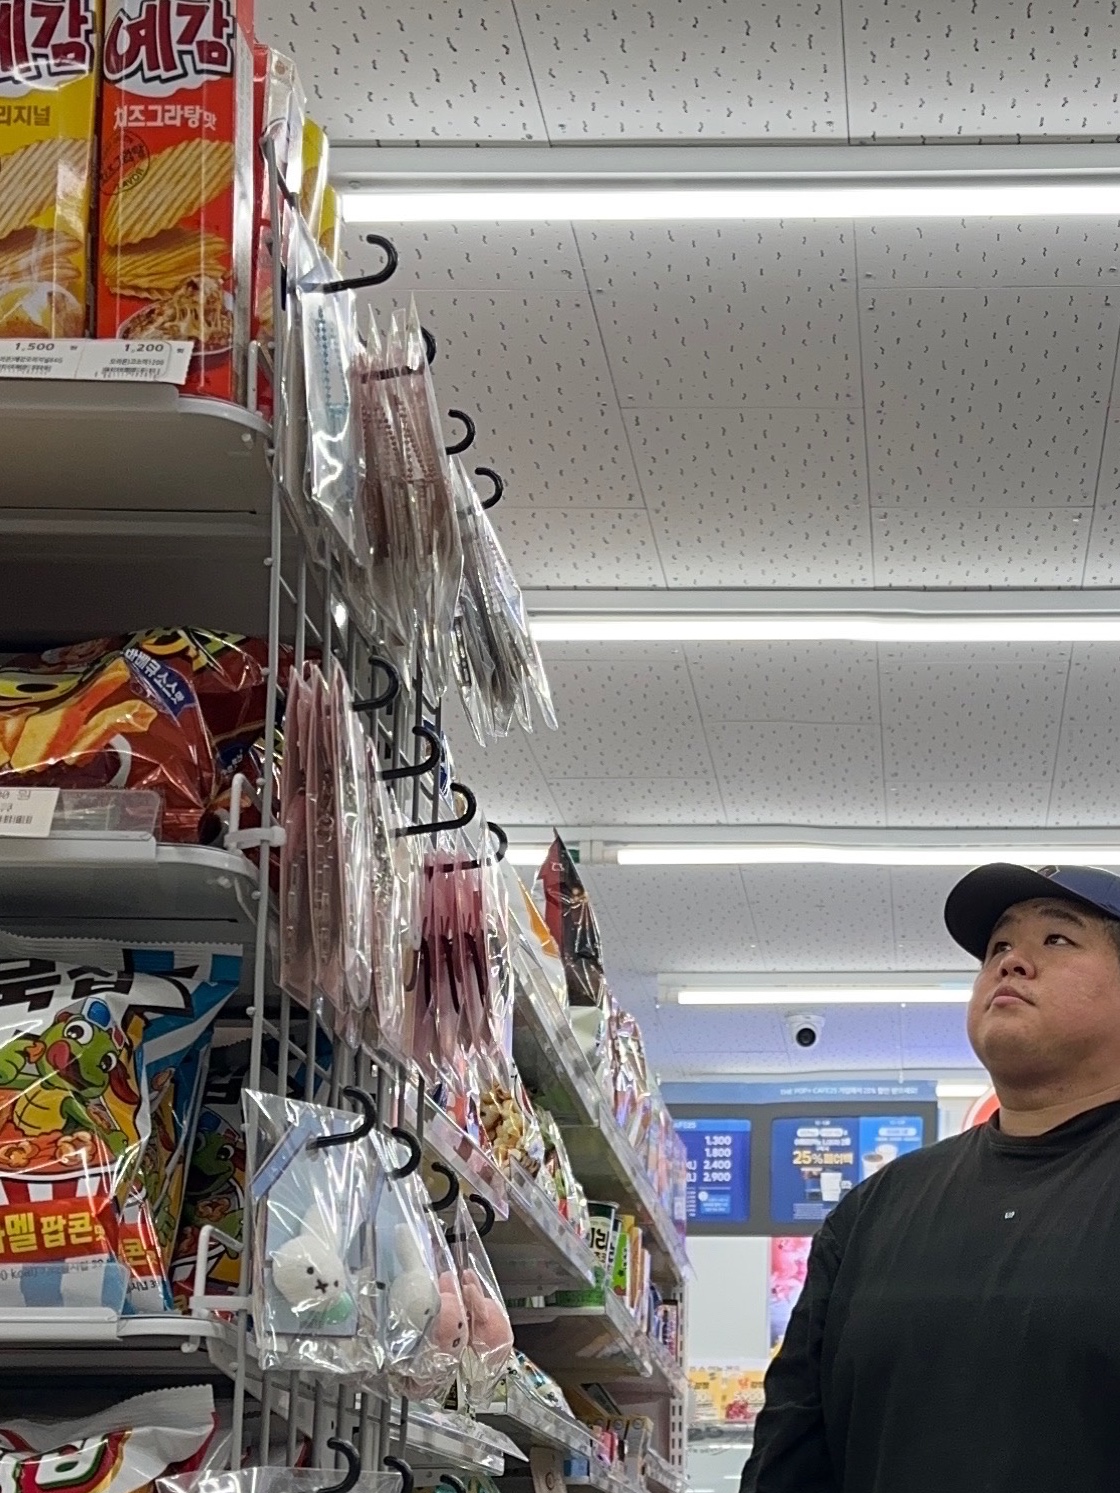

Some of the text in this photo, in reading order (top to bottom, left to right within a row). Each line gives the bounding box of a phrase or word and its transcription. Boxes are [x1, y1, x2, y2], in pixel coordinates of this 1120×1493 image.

[104, 0, 230, 74] 예감
[15, 342, 55, 352] 1,500
[124, 343, 164, 353] 1,200
[792, 1150, 823, 1165] 25%
